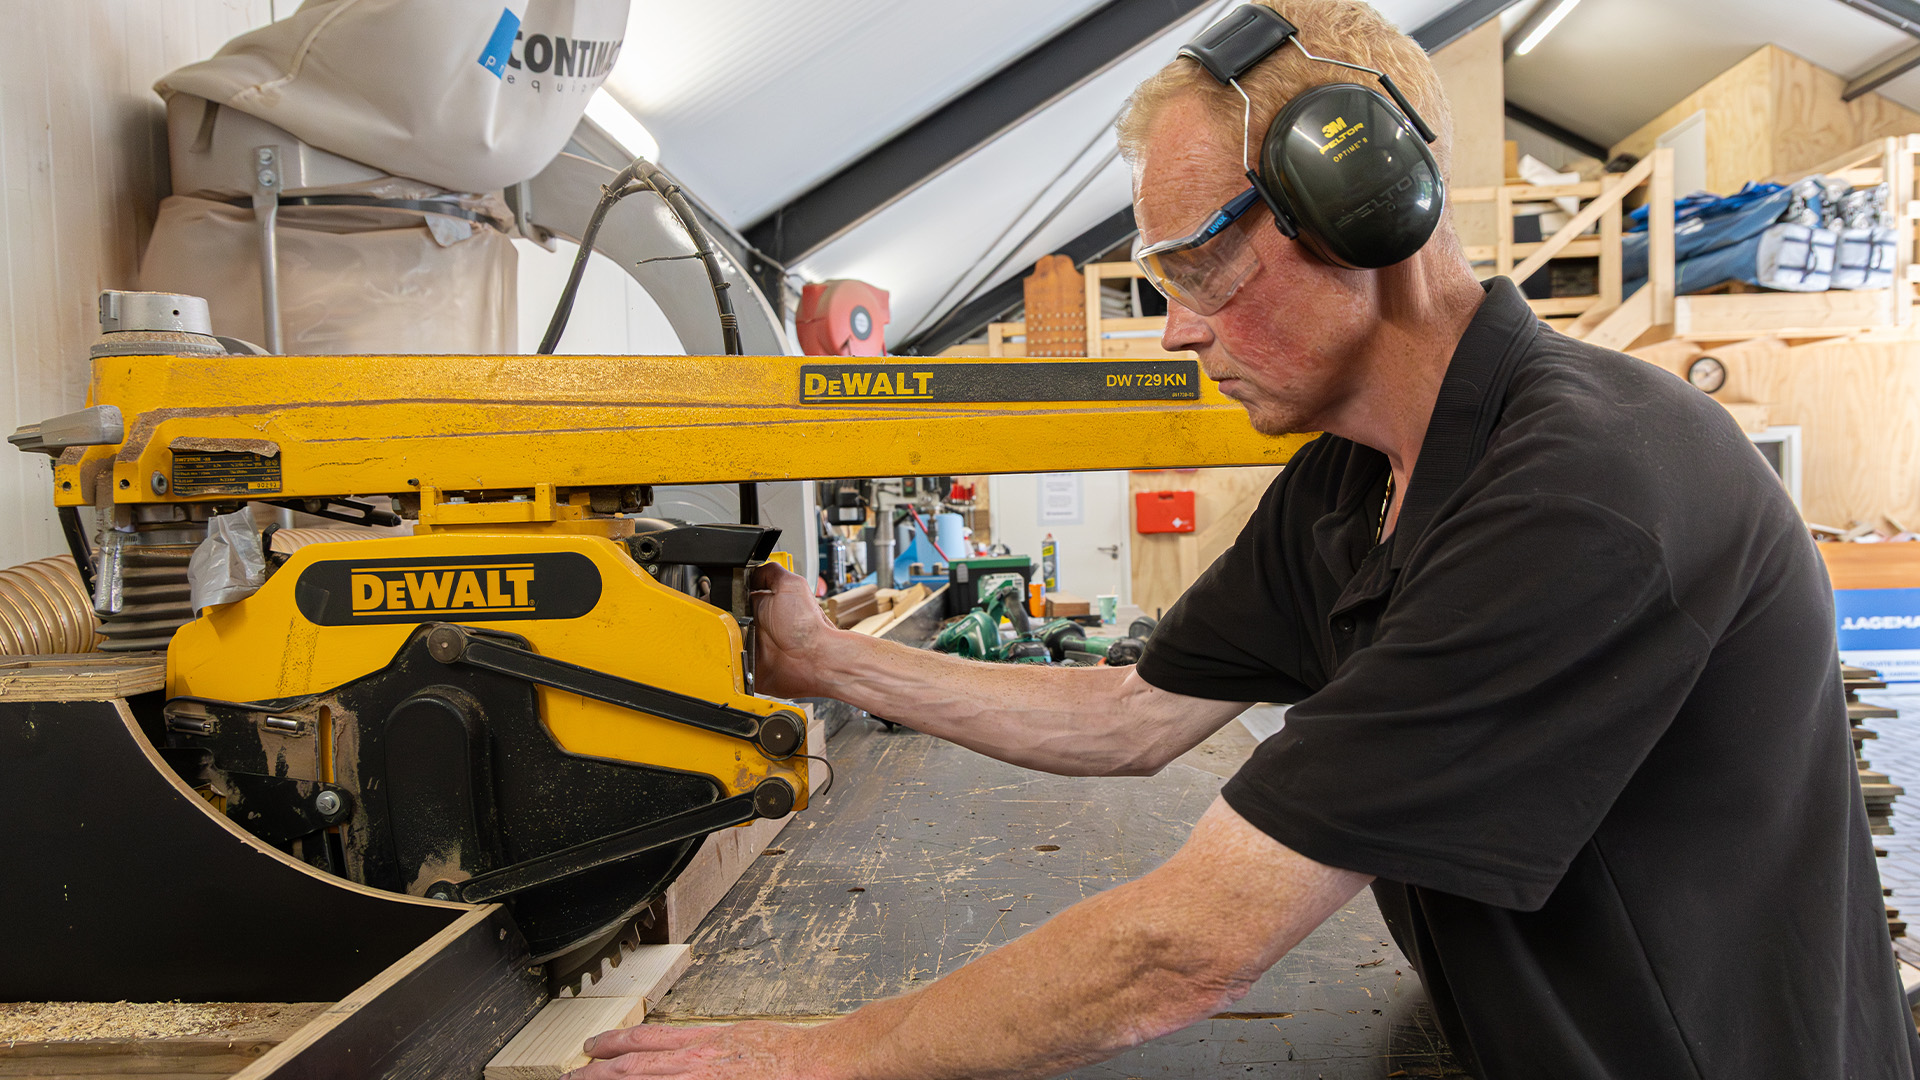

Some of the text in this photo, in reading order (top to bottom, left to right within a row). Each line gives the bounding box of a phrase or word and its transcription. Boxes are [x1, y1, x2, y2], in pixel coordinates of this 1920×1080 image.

[1319, 122, 1365, 155] PELTOR
[1321, 116, 1348, 139] 3M
[1335, 175, 1420, 229] PELTO
[1106, 374, 1132, 387] DW
[1135, 373, 1162, 387] 729
[1163, 373, 1187, 386] KN
